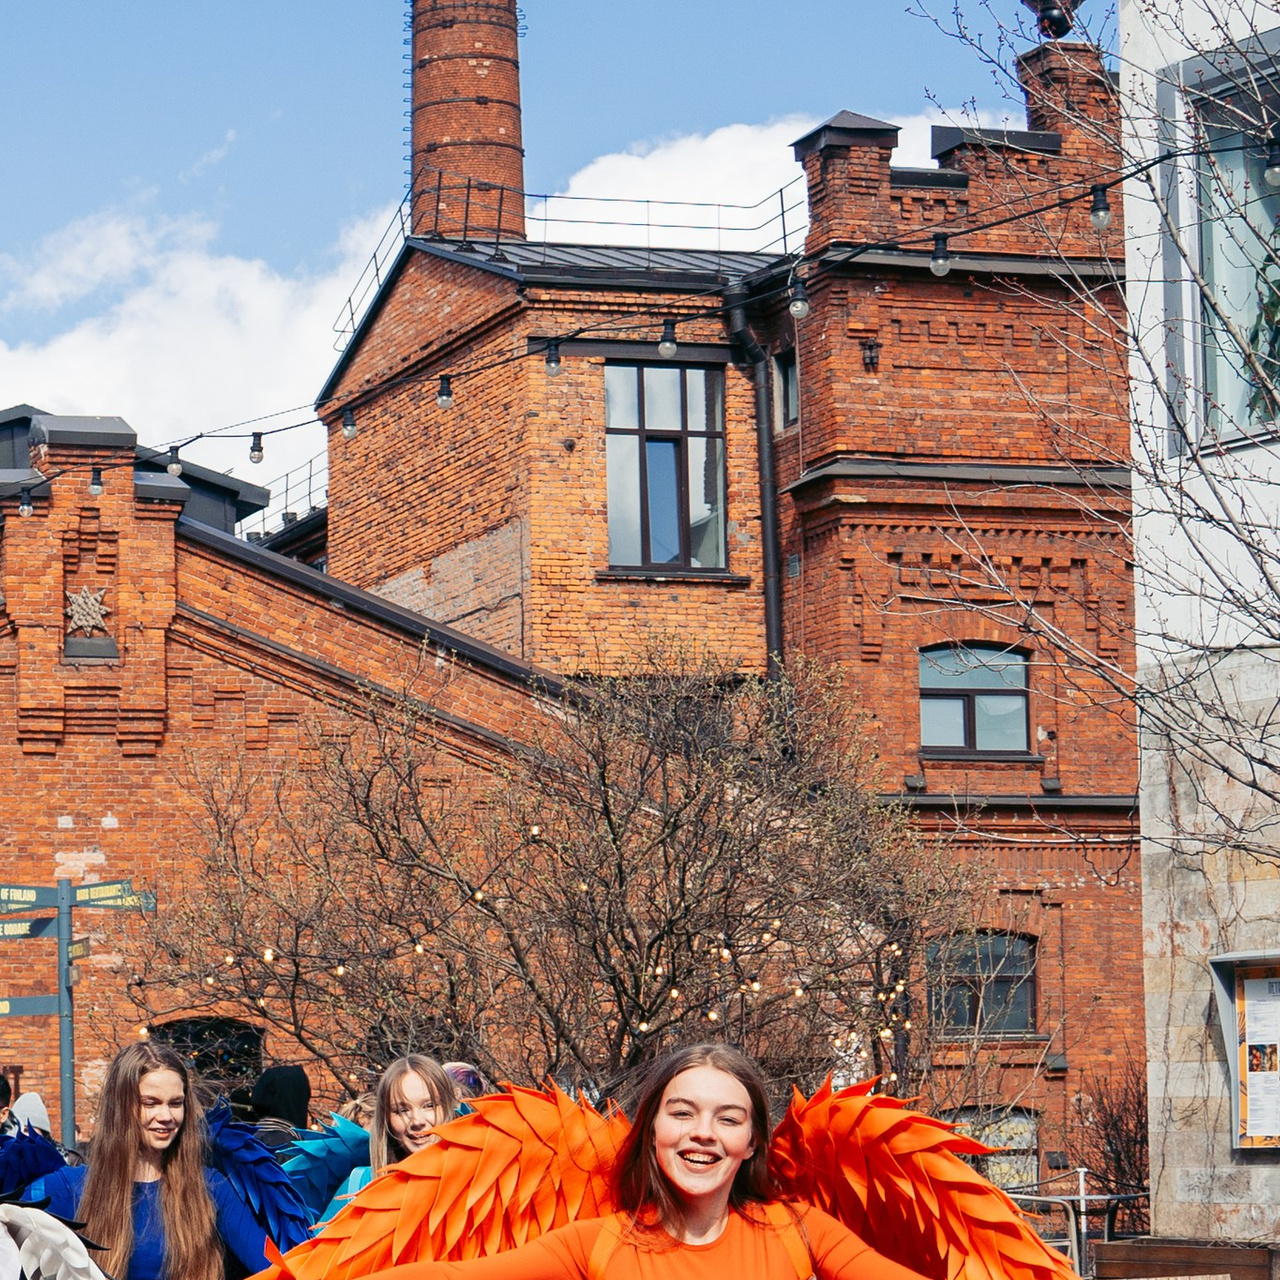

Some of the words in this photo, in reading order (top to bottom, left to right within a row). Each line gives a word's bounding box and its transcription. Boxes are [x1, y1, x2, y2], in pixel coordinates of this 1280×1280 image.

[1, 888, 10, 900] OF
[10, 888, 37, 902] FINLAND
[4, 922, 31, 935] SQUARE
